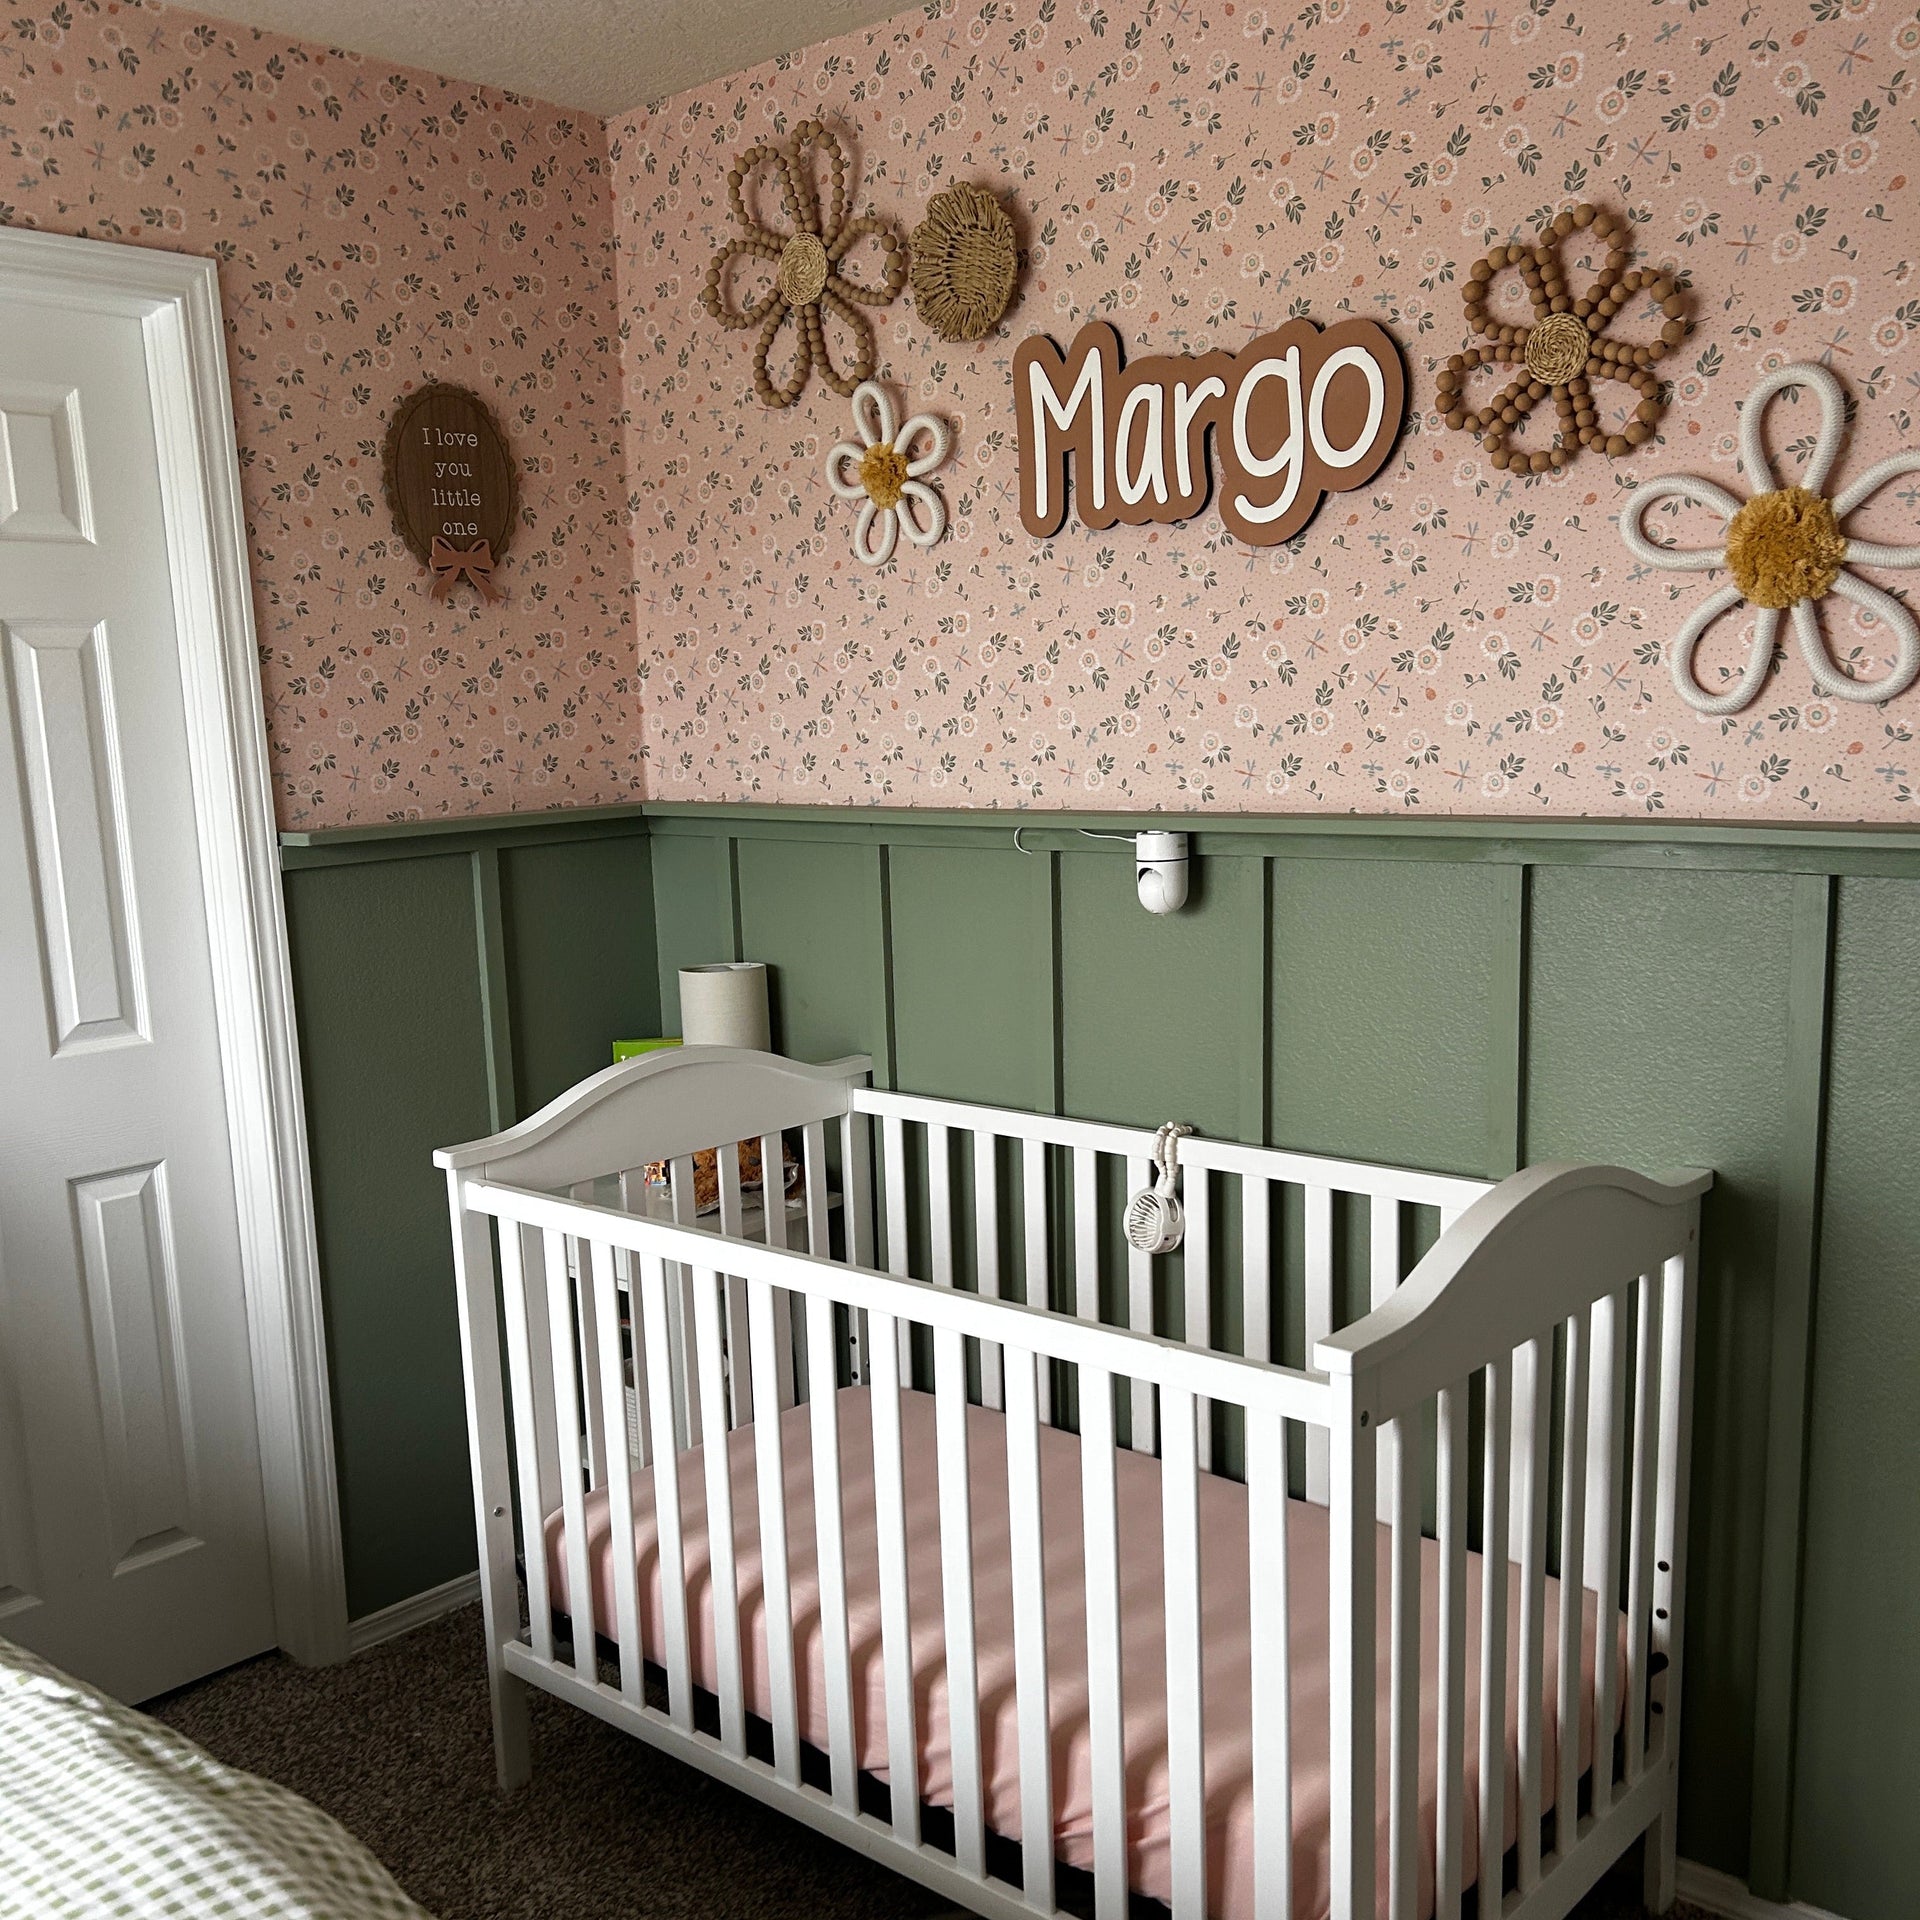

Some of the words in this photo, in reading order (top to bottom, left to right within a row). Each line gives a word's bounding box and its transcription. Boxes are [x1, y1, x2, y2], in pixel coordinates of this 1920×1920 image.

[422, 427, 431, 445] I
[436, 428, 478, 447] love
[1029, 346, 1384, 523] Margo
[434, 462, 472, 478] you
[431, 488, 481, 507] little
[442, 521, 478, 536] one
